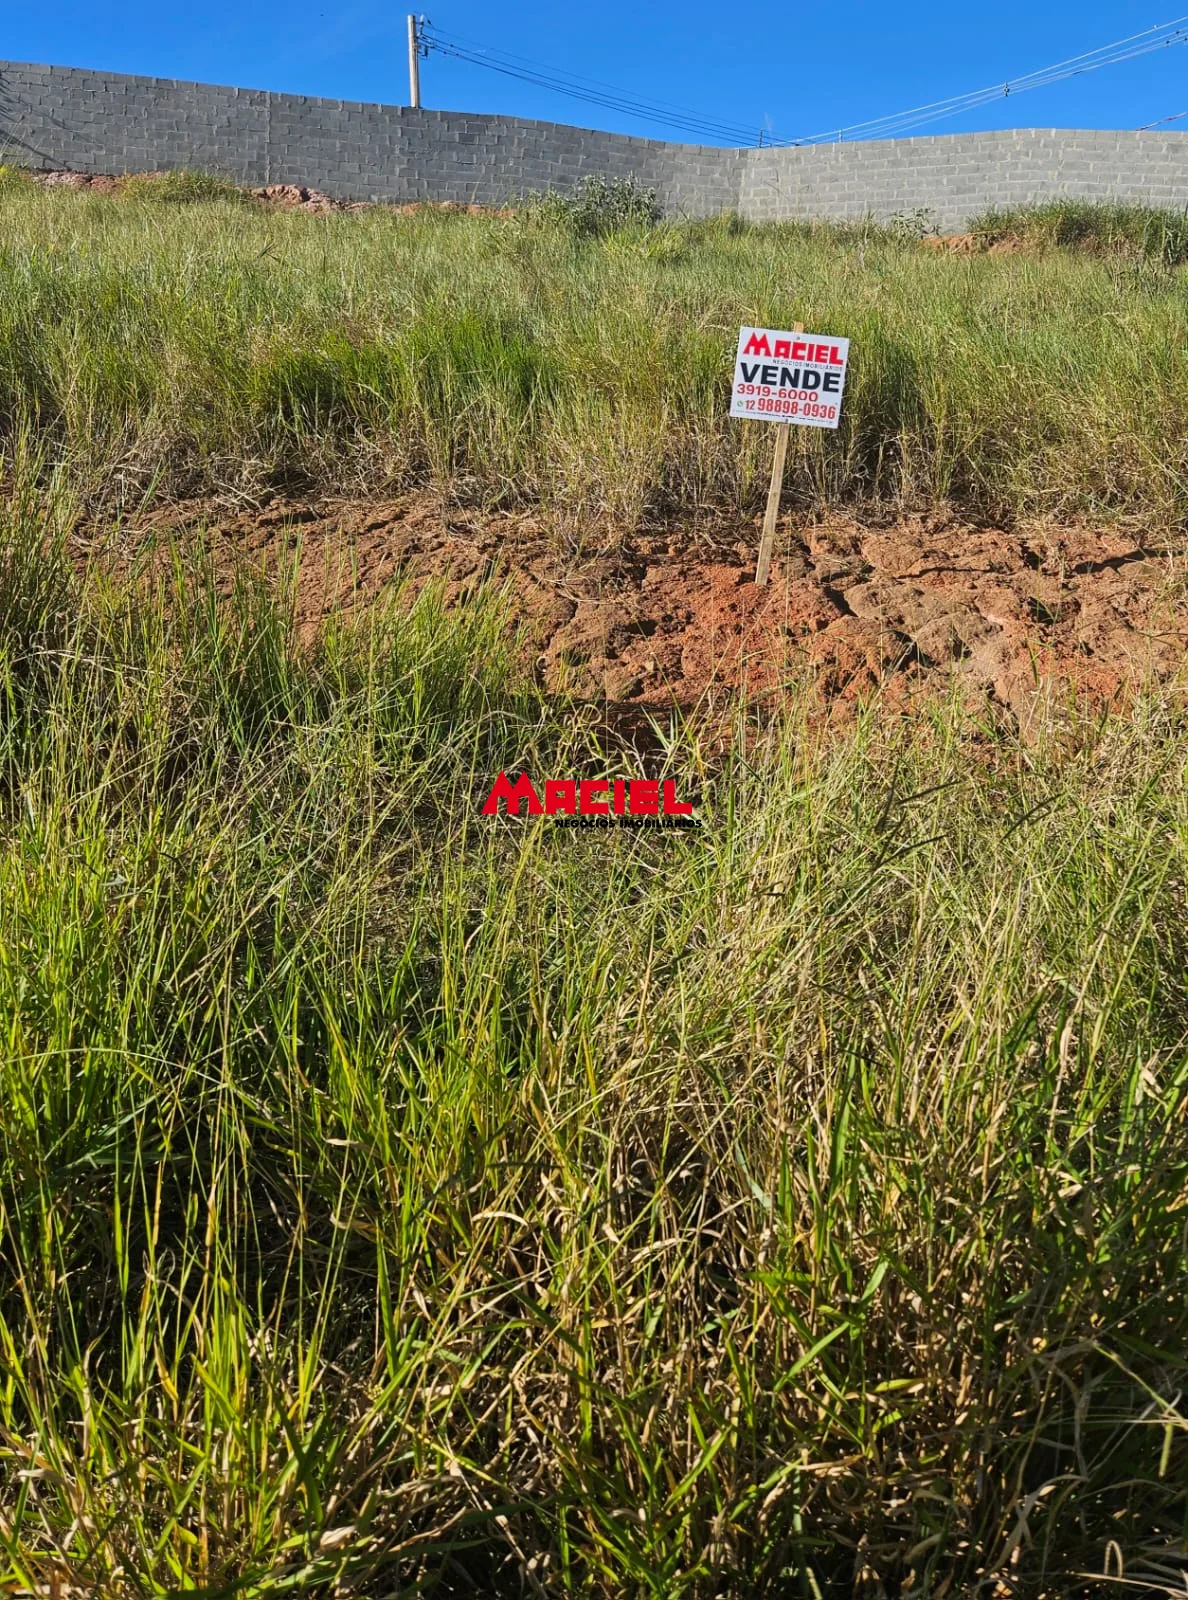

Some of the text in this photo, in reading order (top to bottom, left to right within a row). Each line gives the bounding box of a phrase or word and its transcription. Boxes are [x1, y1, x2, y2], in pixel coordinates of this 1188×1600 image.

[743, 332, 844, 365] MACIEL
[740, 362, 841, 393] VENDE
[737, 383, 818, 402] 3919-6000
[745, 399, 756, 410] 12
[757, 398, 836, 419] 98898-0936
